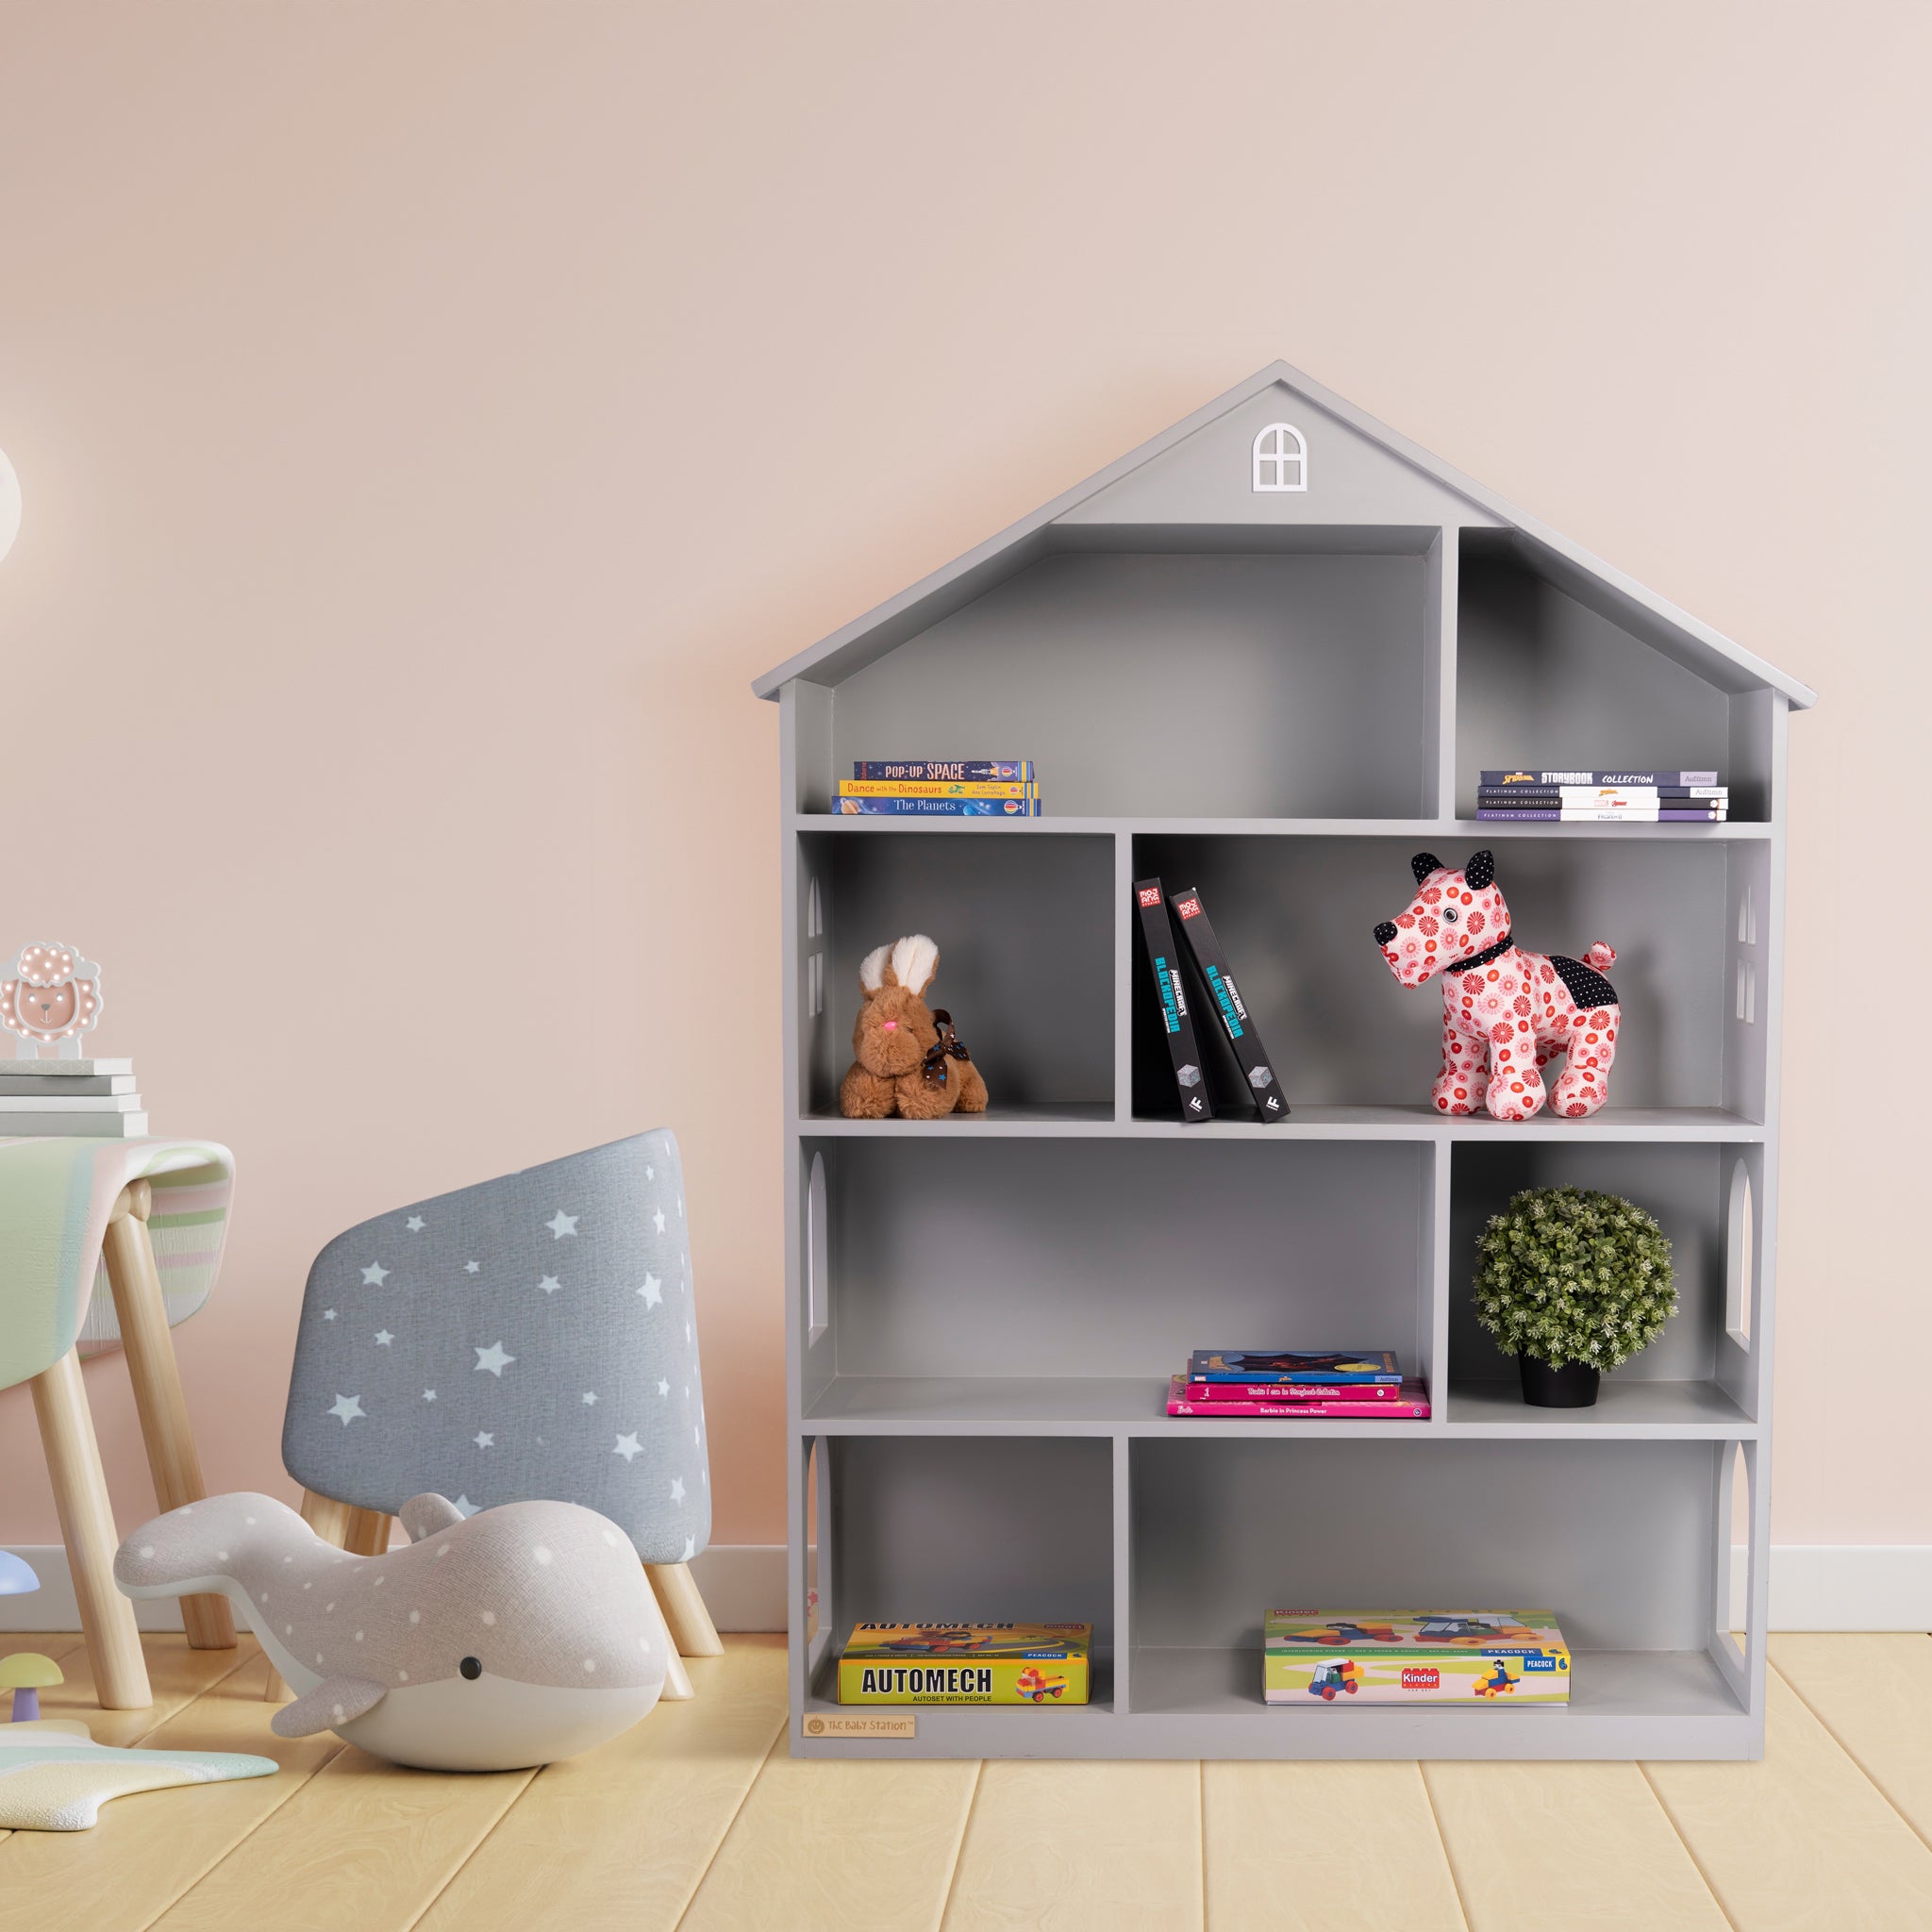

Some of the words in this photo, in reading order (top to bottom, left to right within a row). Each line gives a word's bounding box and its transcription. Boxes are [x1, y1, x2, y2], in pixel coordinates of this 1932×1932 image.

[885, 765, 924, 778] POP-UP
[926, 762, 965, 780] SPACE
[1541, 772, 1593, 785] STORYBOOK
[1602, 774, 1654, 784] COLLECTION
[847, 782, 874, 792] Dance
[898, 783, 942, 794] Dinosaurs
[893, 799, 914, 810] The
[917, 799, 956, 811] Planets
[1169, 969, 1188, 1017] MINECRAFT
[1221, 974, 1248, 1021] MINECRAFT
[860, 1667, 992, 1694] AUTOMECH
[1403, 1674, 1438, 1683] Kinder
